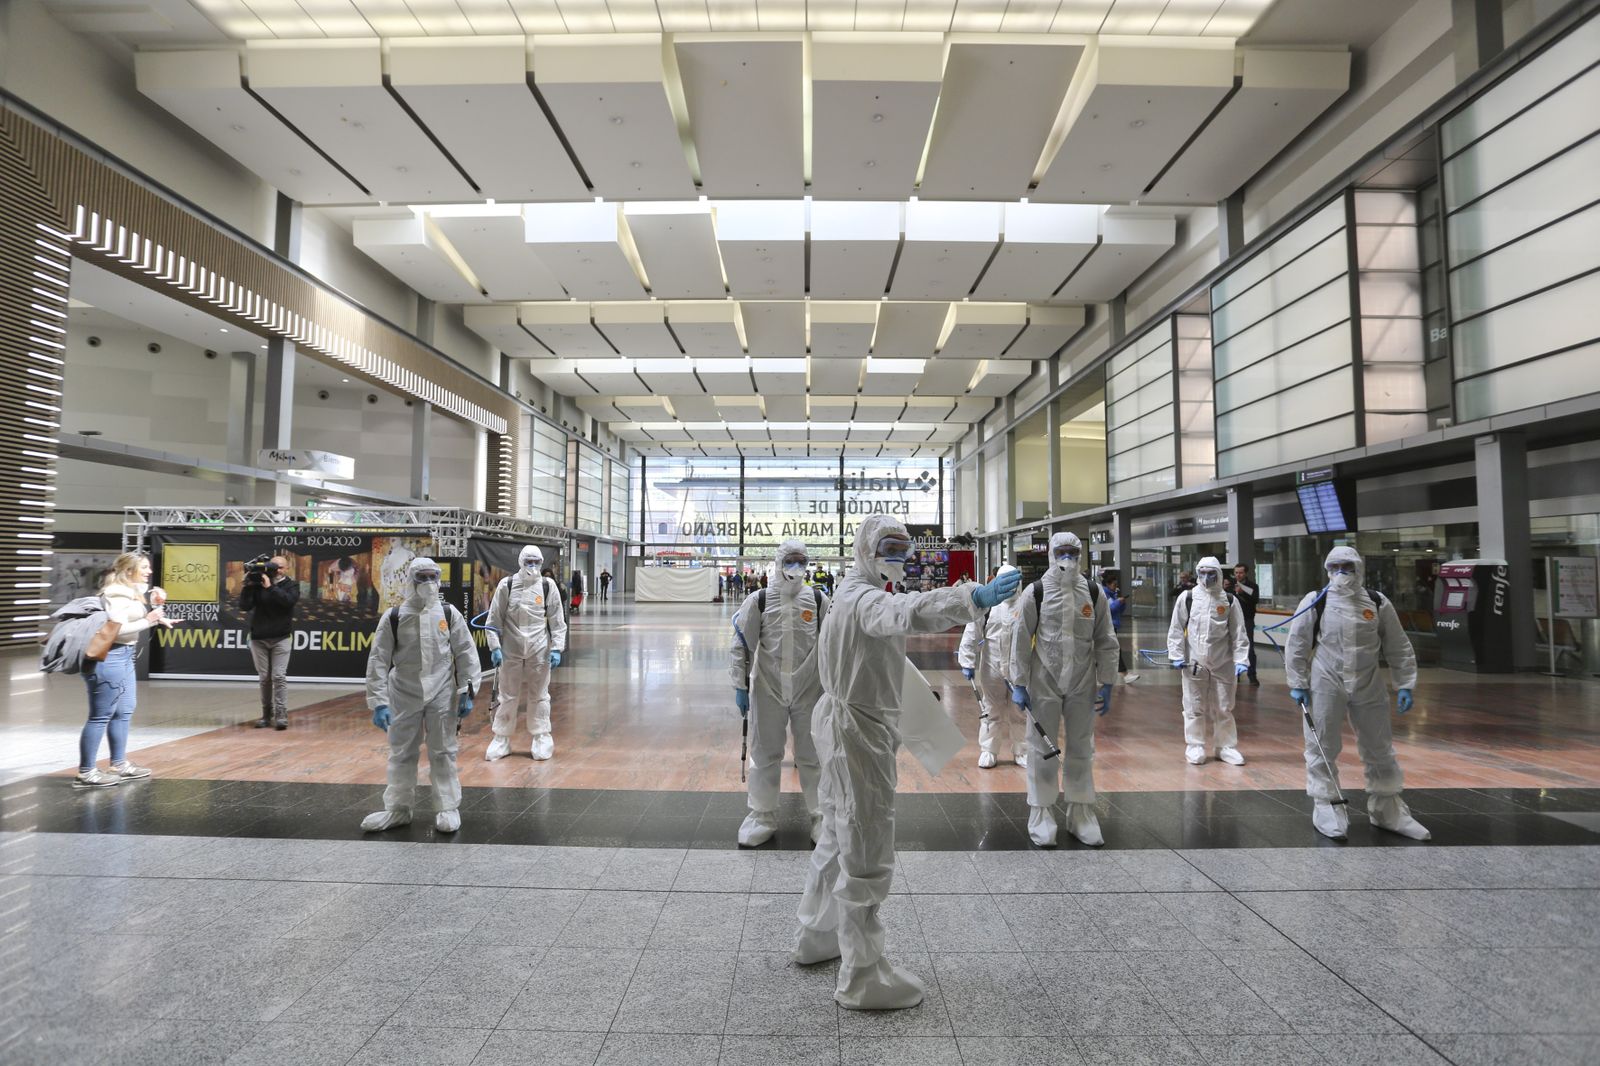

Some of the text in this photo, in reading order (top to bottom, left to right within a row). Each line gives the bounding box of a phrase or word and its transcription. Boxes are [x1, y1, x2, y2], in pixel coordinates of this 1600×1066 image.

[185, 563, 210, 574] ORO
[1491, 565, 1511, 616] renfe
[164, 603, 220, 613] XPOSICIÓN
[1436, 619, 1460, 631] renfe
